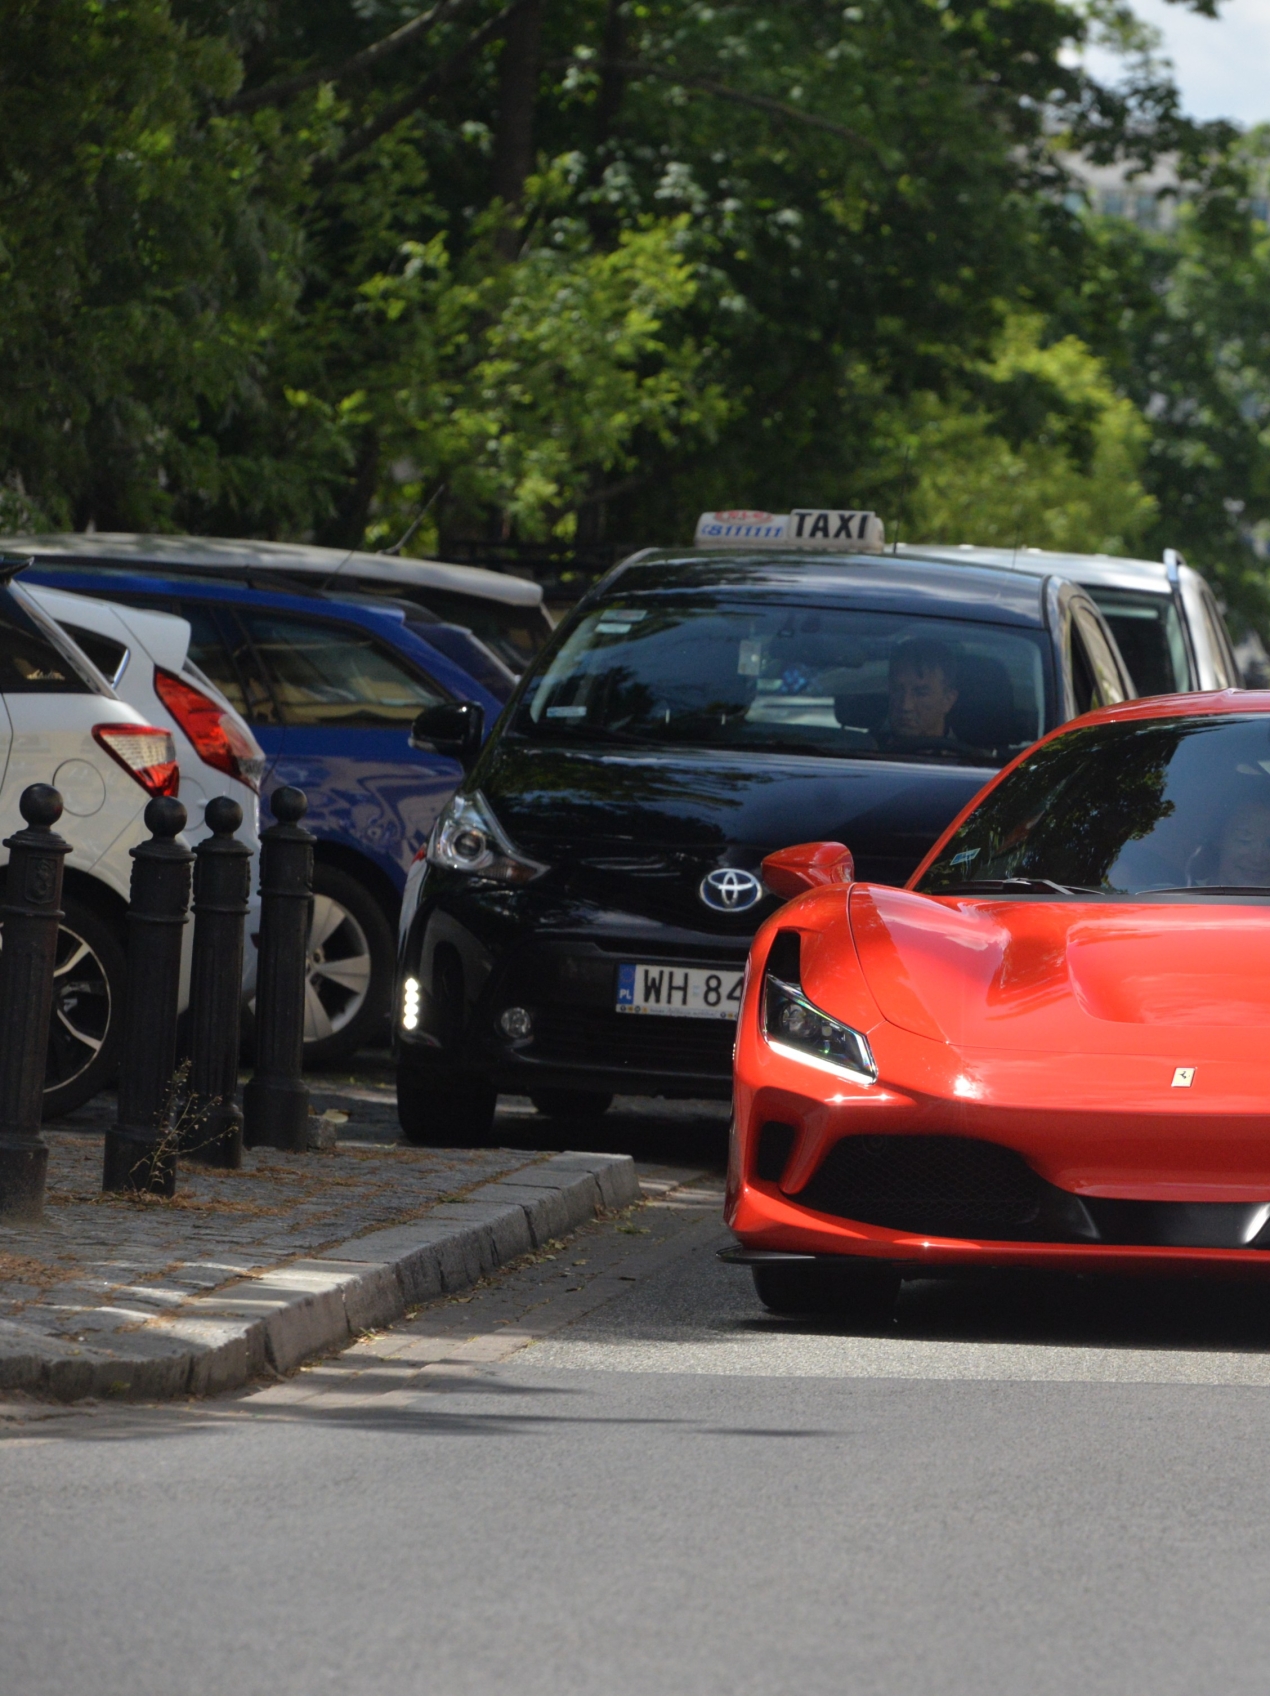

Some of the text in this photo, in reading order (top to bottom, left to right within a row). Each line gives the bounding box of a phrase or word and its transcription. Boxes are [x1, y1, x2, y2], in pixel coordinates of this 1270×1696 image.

[793, 512, 870, 539] TAXI
[619, 988, 632, 1000] PL
[643, 969, 689, 1006] WH
